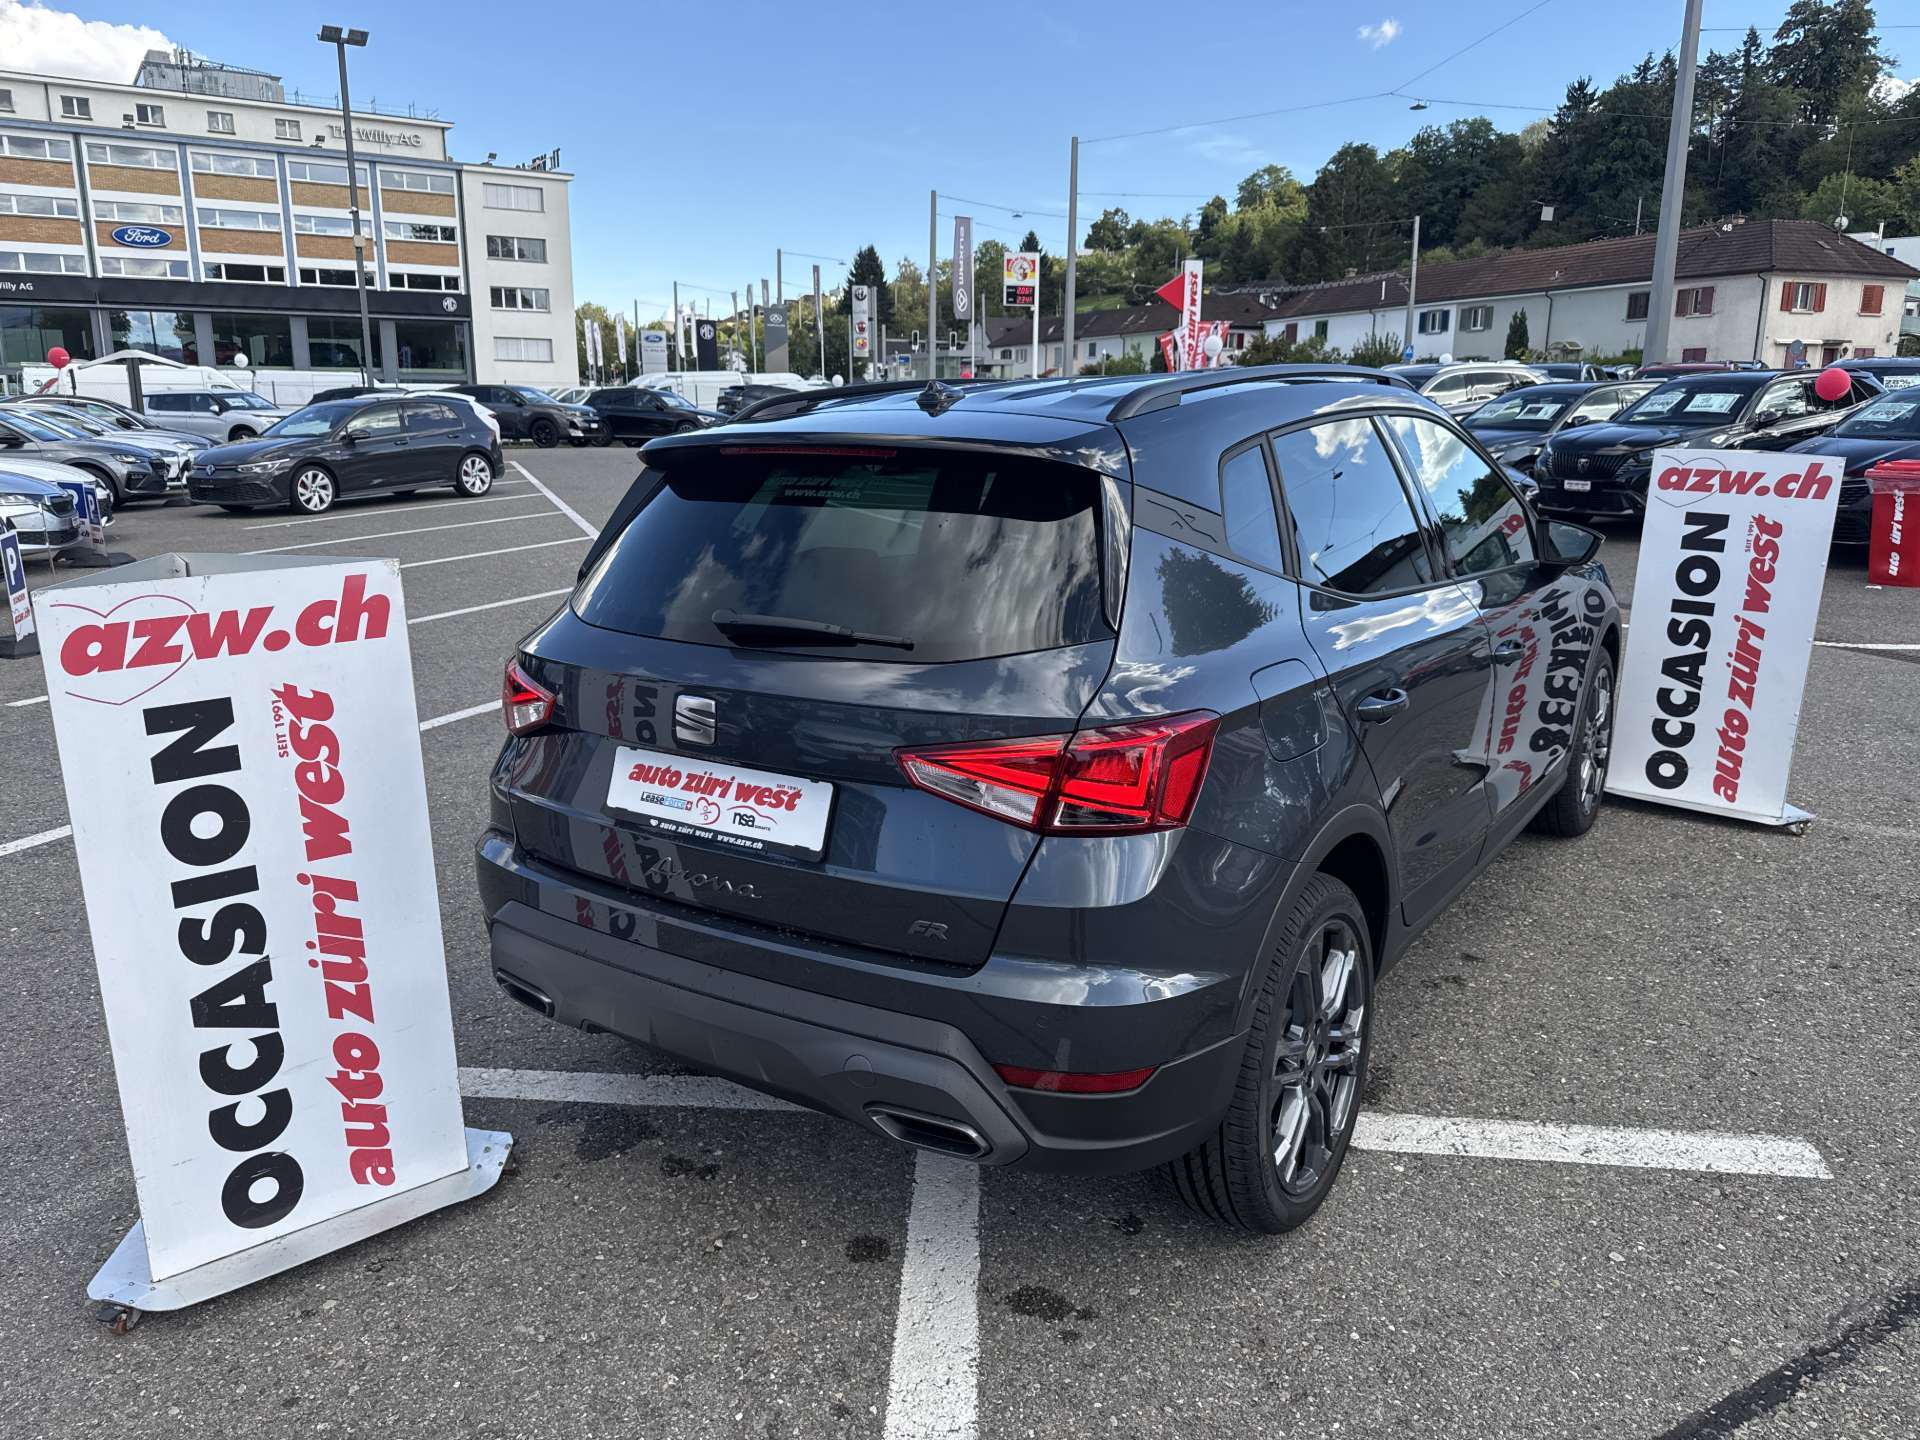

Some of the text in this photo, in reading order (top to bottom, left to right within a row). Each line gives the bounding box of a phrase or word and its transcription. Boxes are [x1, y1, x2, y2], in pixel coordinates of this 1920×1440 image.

[358, 127, 393, 146] Willy
[399, 129, 423, 147] AG
[124, 228, 160, 244] Ford
[1721, 223, 1733, 232] 48
[19, 282, 34, 291] AG
[1657, 463, 1833, 500] azw.ch
[6, 547, 17, 586] P
[60, 573, 391, 677] azw.ch
[1645, 511, 1730, 790] OCCASION
[1713, 513, 1783, 803] auto züri west
[272, 699, 289, 758] SEIT 1991
[628, 763, 803, 812] auto züri west
[659, 821, 764, 850] auto züri west www.azw.ch
[732, 811, 756, 829] nsa
[644, 856, 762, 899] Arona
[270, 682, 396, 1187] auto züri west
[907, 919, 949, 941] FR
[142, 696, 305, 1229] OCCASION
